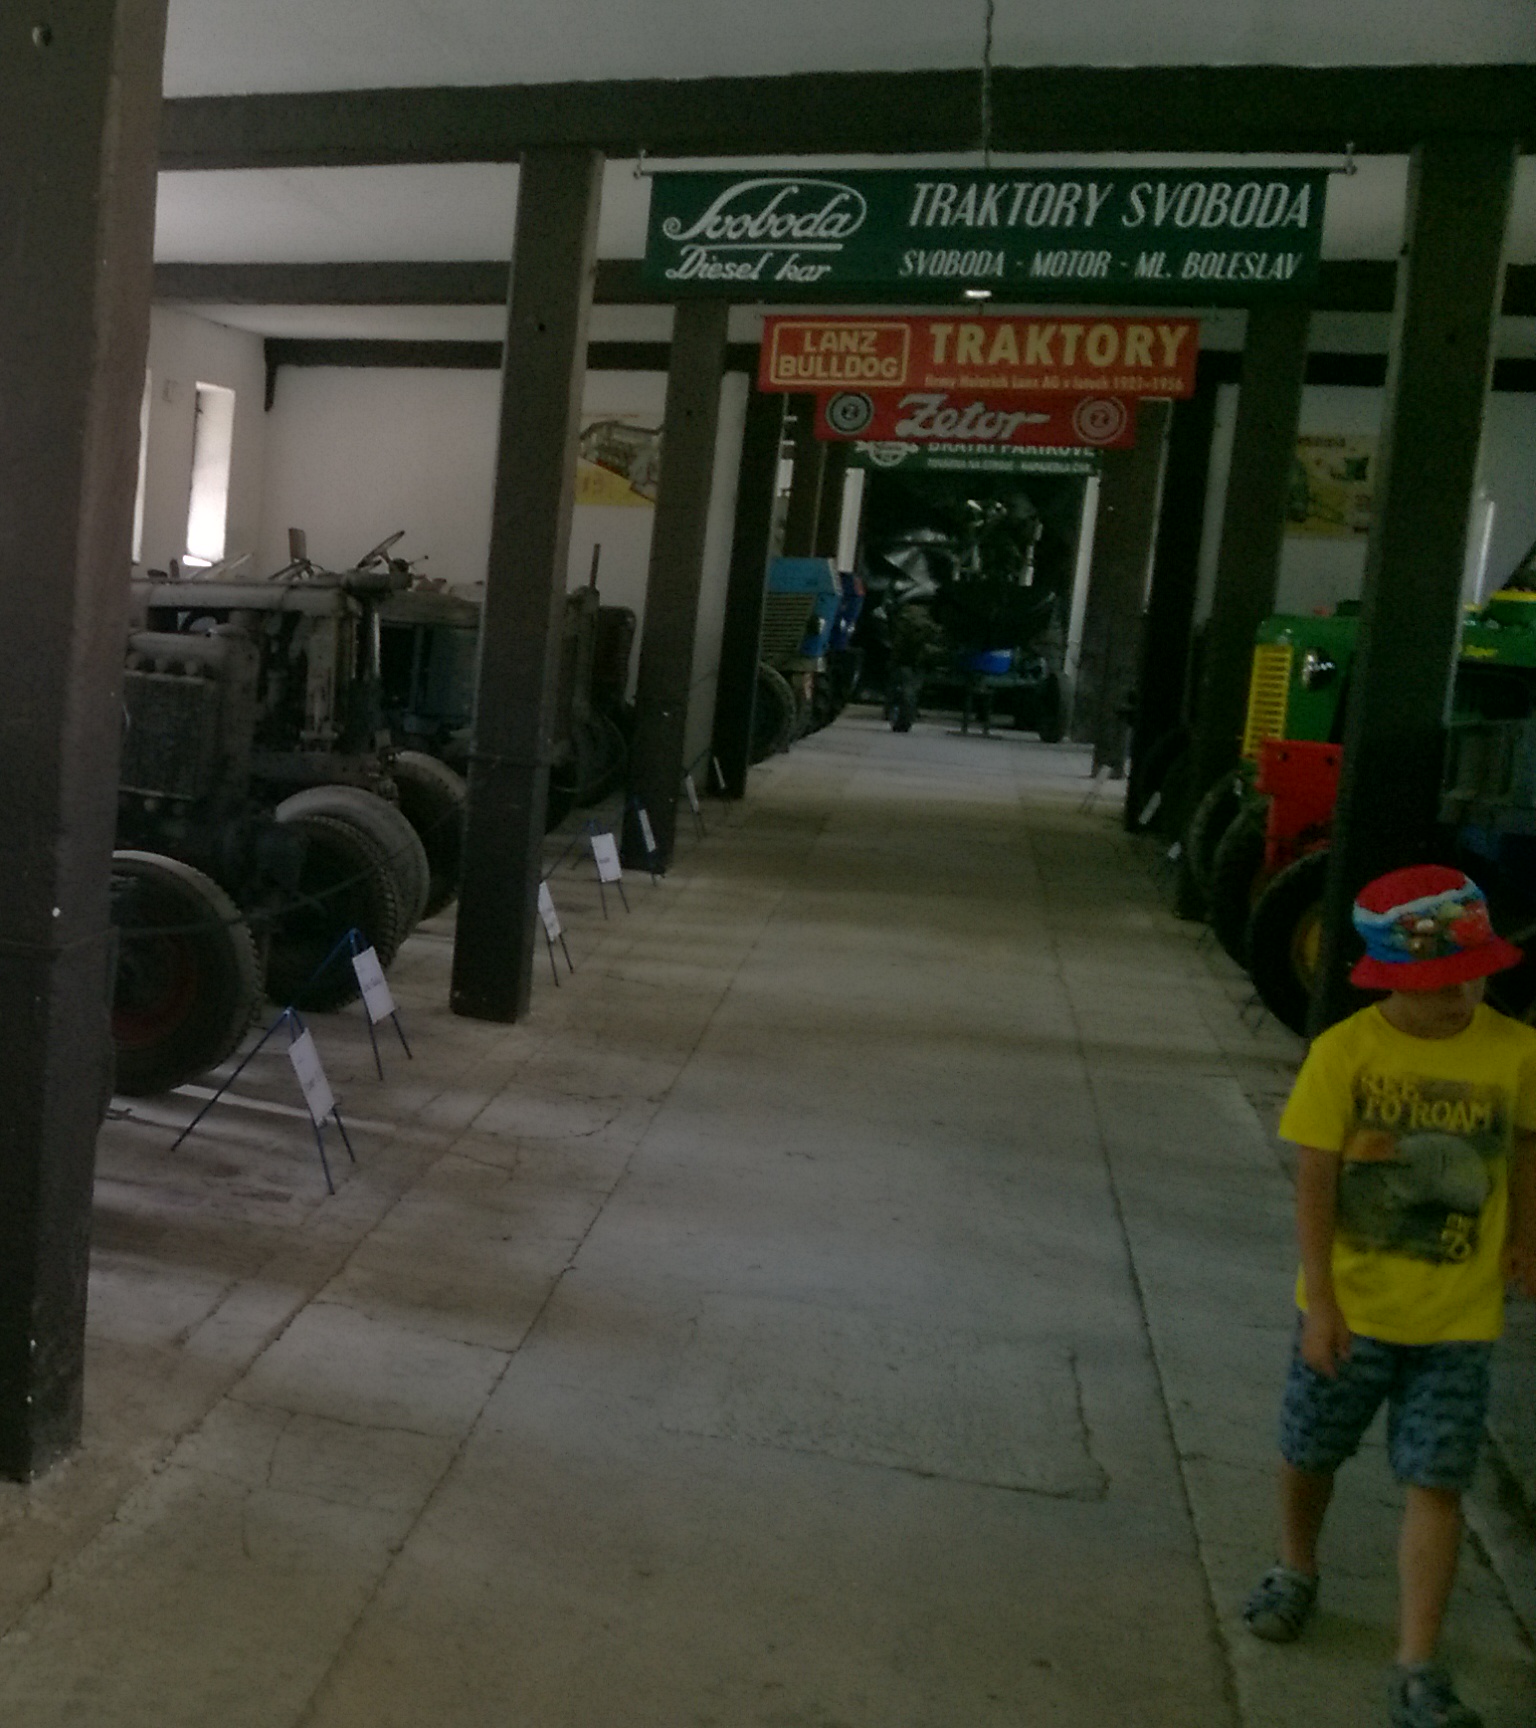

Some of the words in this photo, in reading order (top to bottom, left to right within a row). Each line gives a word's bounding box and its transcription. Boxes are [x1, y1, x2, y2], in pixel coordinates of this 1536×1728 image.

[663, 178, 867, 240] Svoboda
[909, 182, 1115, 227] TRAKTORY
[1122, 182, 1310, 228] SVOBODA
[665, 245, 773, 280] Diesel
[898, 249, 1005, 277] SVOBODA
[1029, 250, 1112, 278] MOTOR
[1181, 251, 1303, 279] BOLESLAV
[803, 331, 879, 353] LANZ
[929, 323, 1190, 368] TRAKTORY
[778, 356, 899, 379] BULLDOG
[895, 393, 1051, 439] Zetor
[1363, 1097, 1402, 1125] TO
[1409, 1100, 1492, 1133] ROAM
